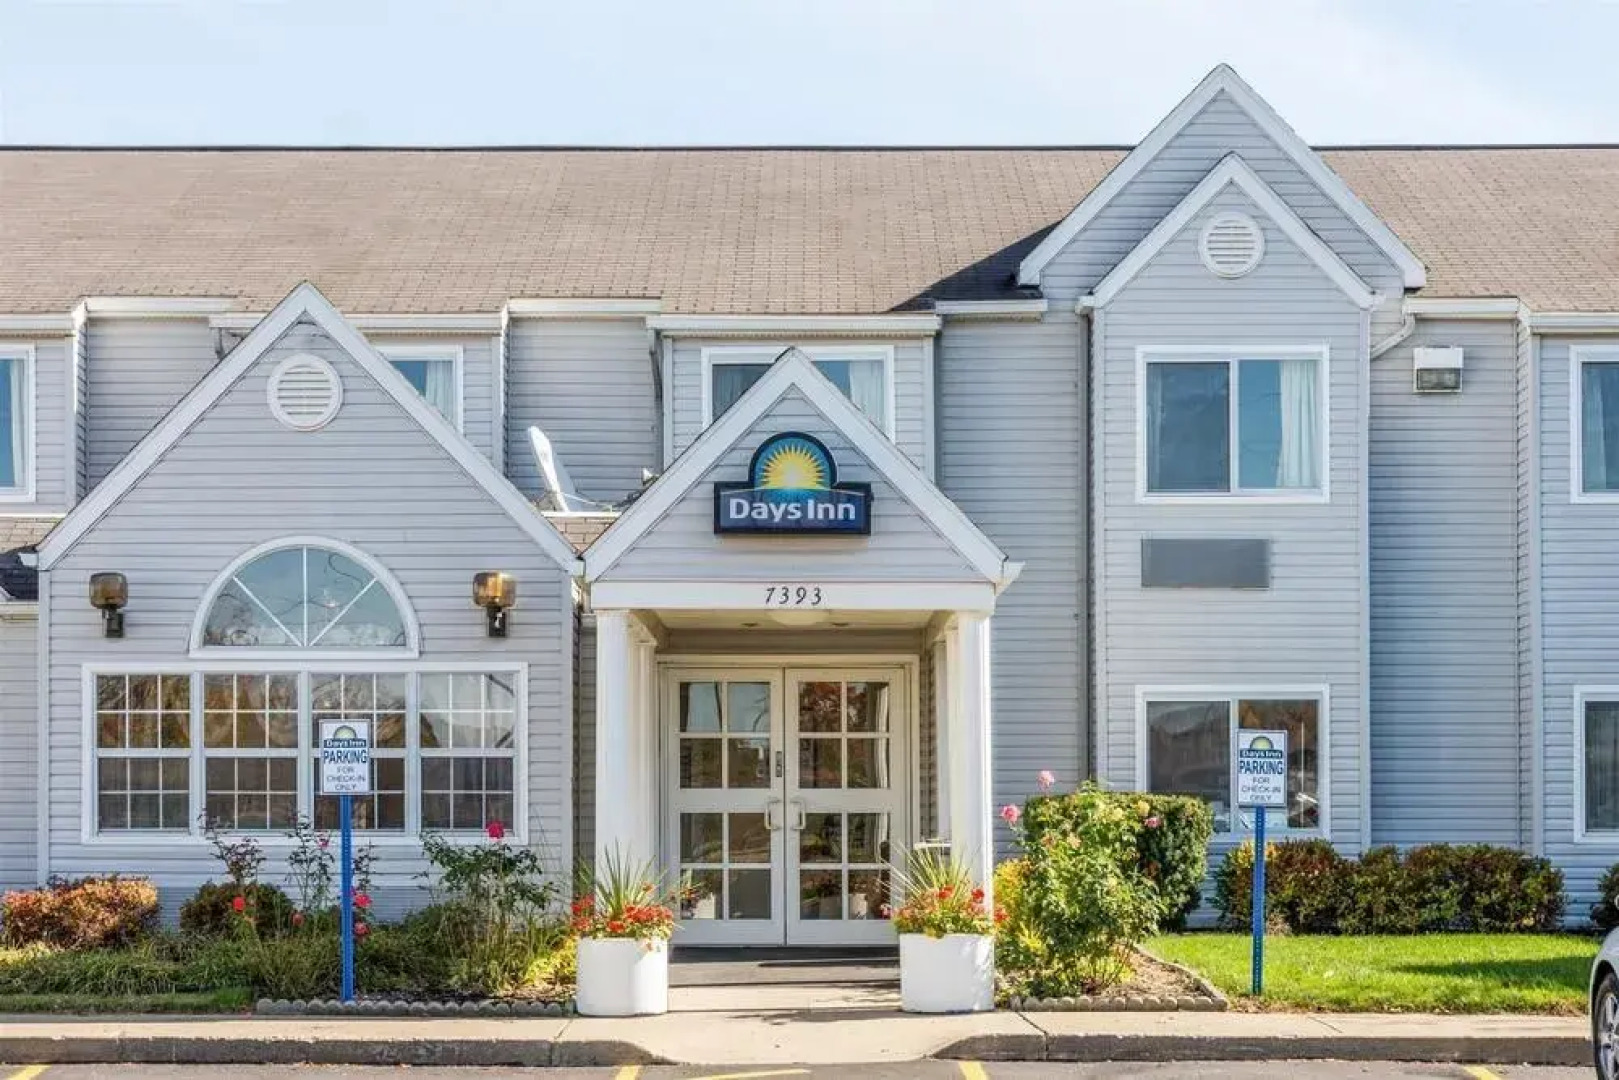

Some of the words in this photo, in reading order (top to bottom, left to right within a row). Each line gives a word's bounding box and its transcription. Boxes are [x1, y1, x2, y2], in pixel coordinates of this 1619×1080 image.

[729, 498, 803, 522] Days
[807, 499, 856, 520] Inn
[765, 586, 821, 605] 7393
[323, 750, 367, 764] PARKING
[1239, 761, 1283, 774] PARKING
